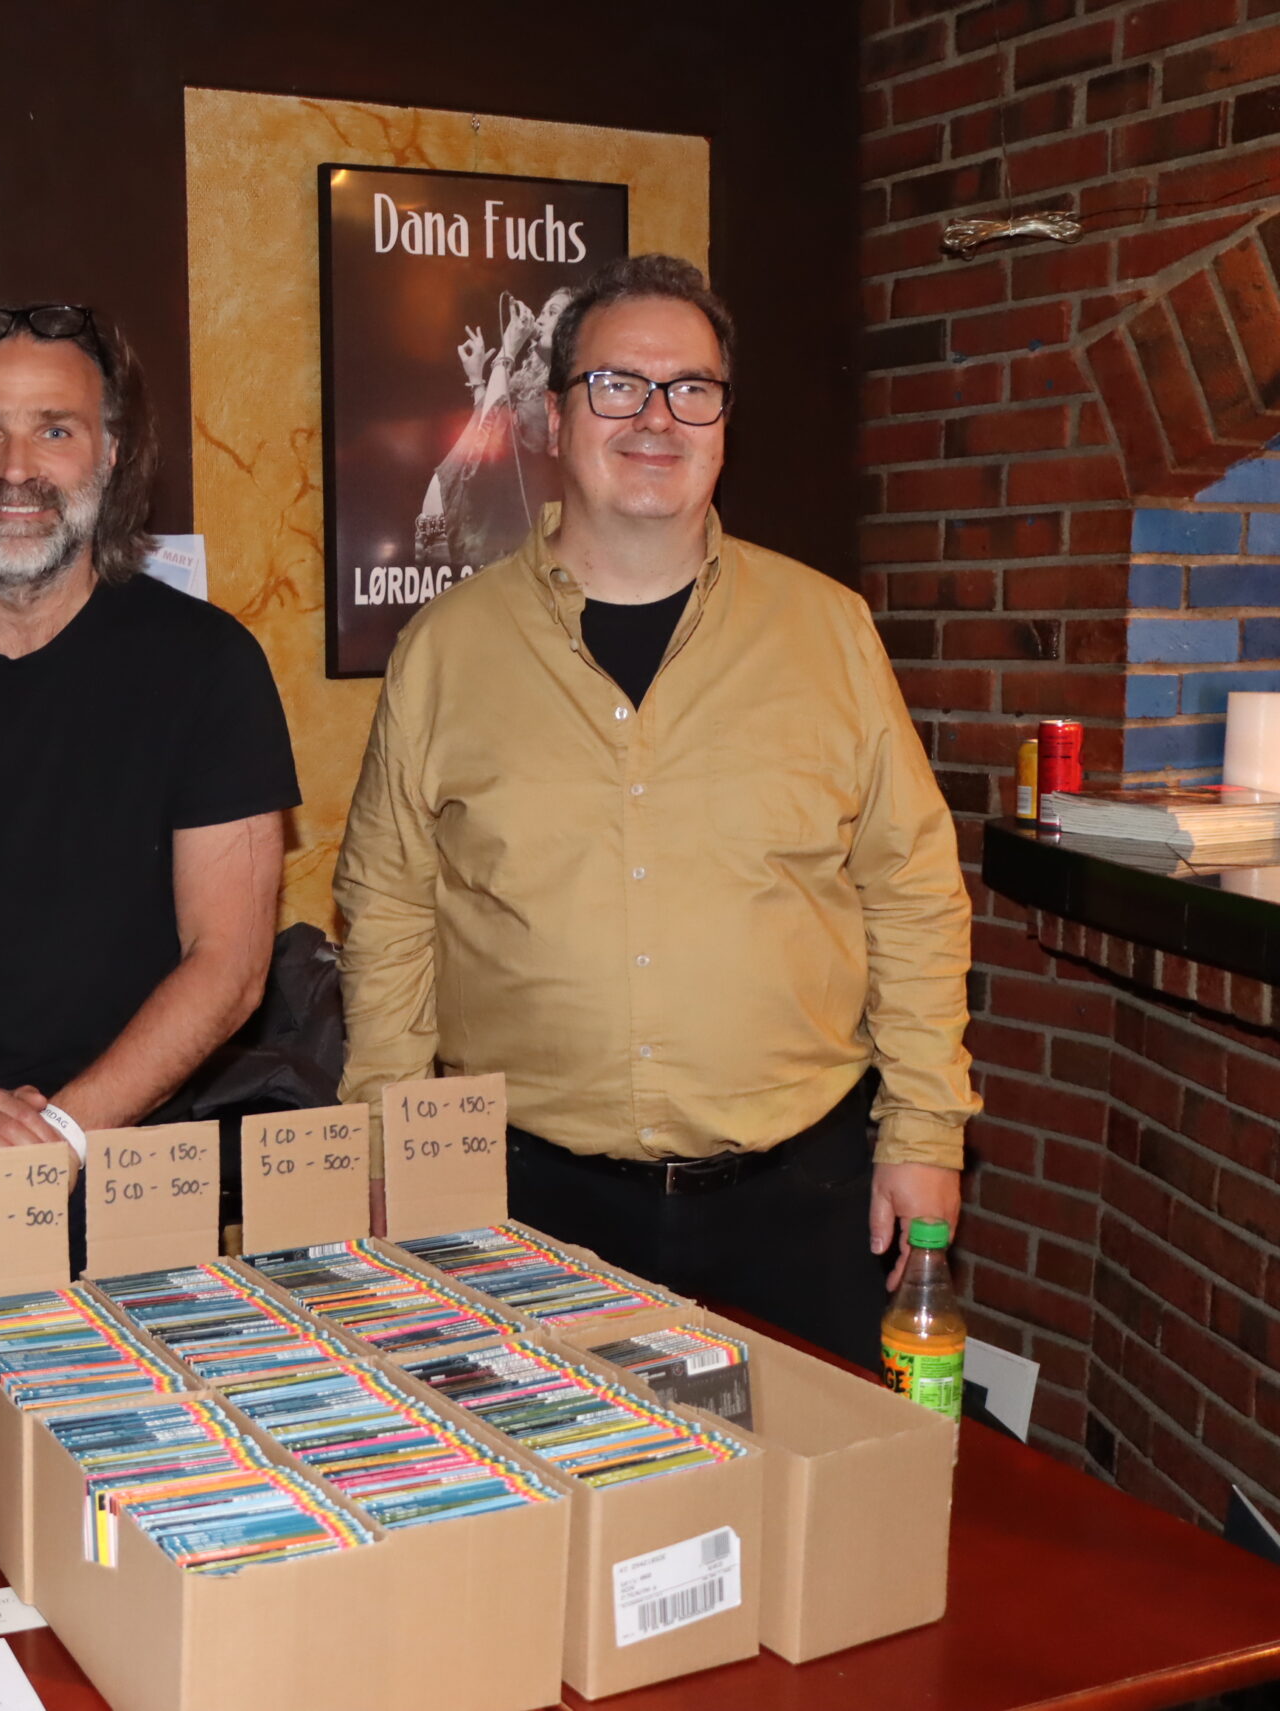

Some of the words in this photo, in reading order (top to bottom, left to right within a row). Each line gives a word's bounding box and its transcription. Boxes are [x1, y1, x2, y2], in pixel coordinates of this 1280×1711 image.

[373, 192, 470, 258] Dana
[484, 200, 587, 264] Fuchs
[162, 550, 194, 567] MARY
[354, 565, 453, 606] LØRDAG
[401, 1096, 410, 1122] 1
[416, 1100, 438, 1119] CD
[259, 1127, 268, 1147] 1
[275, 1127, 296, 1145] CD
[103, 1146, 112, 1169] 1
[119, 1148, 143, 1169] CD
[403, 1139, 416, 1161] 5
[421, 1140, 440, 1157] CD
[260, 1154, 273, 1176] 5
[276, 1158, 296, 1174] CD
[104, 1178, 117, 1204] 5
[123, 1180, 144, 1200] CD
